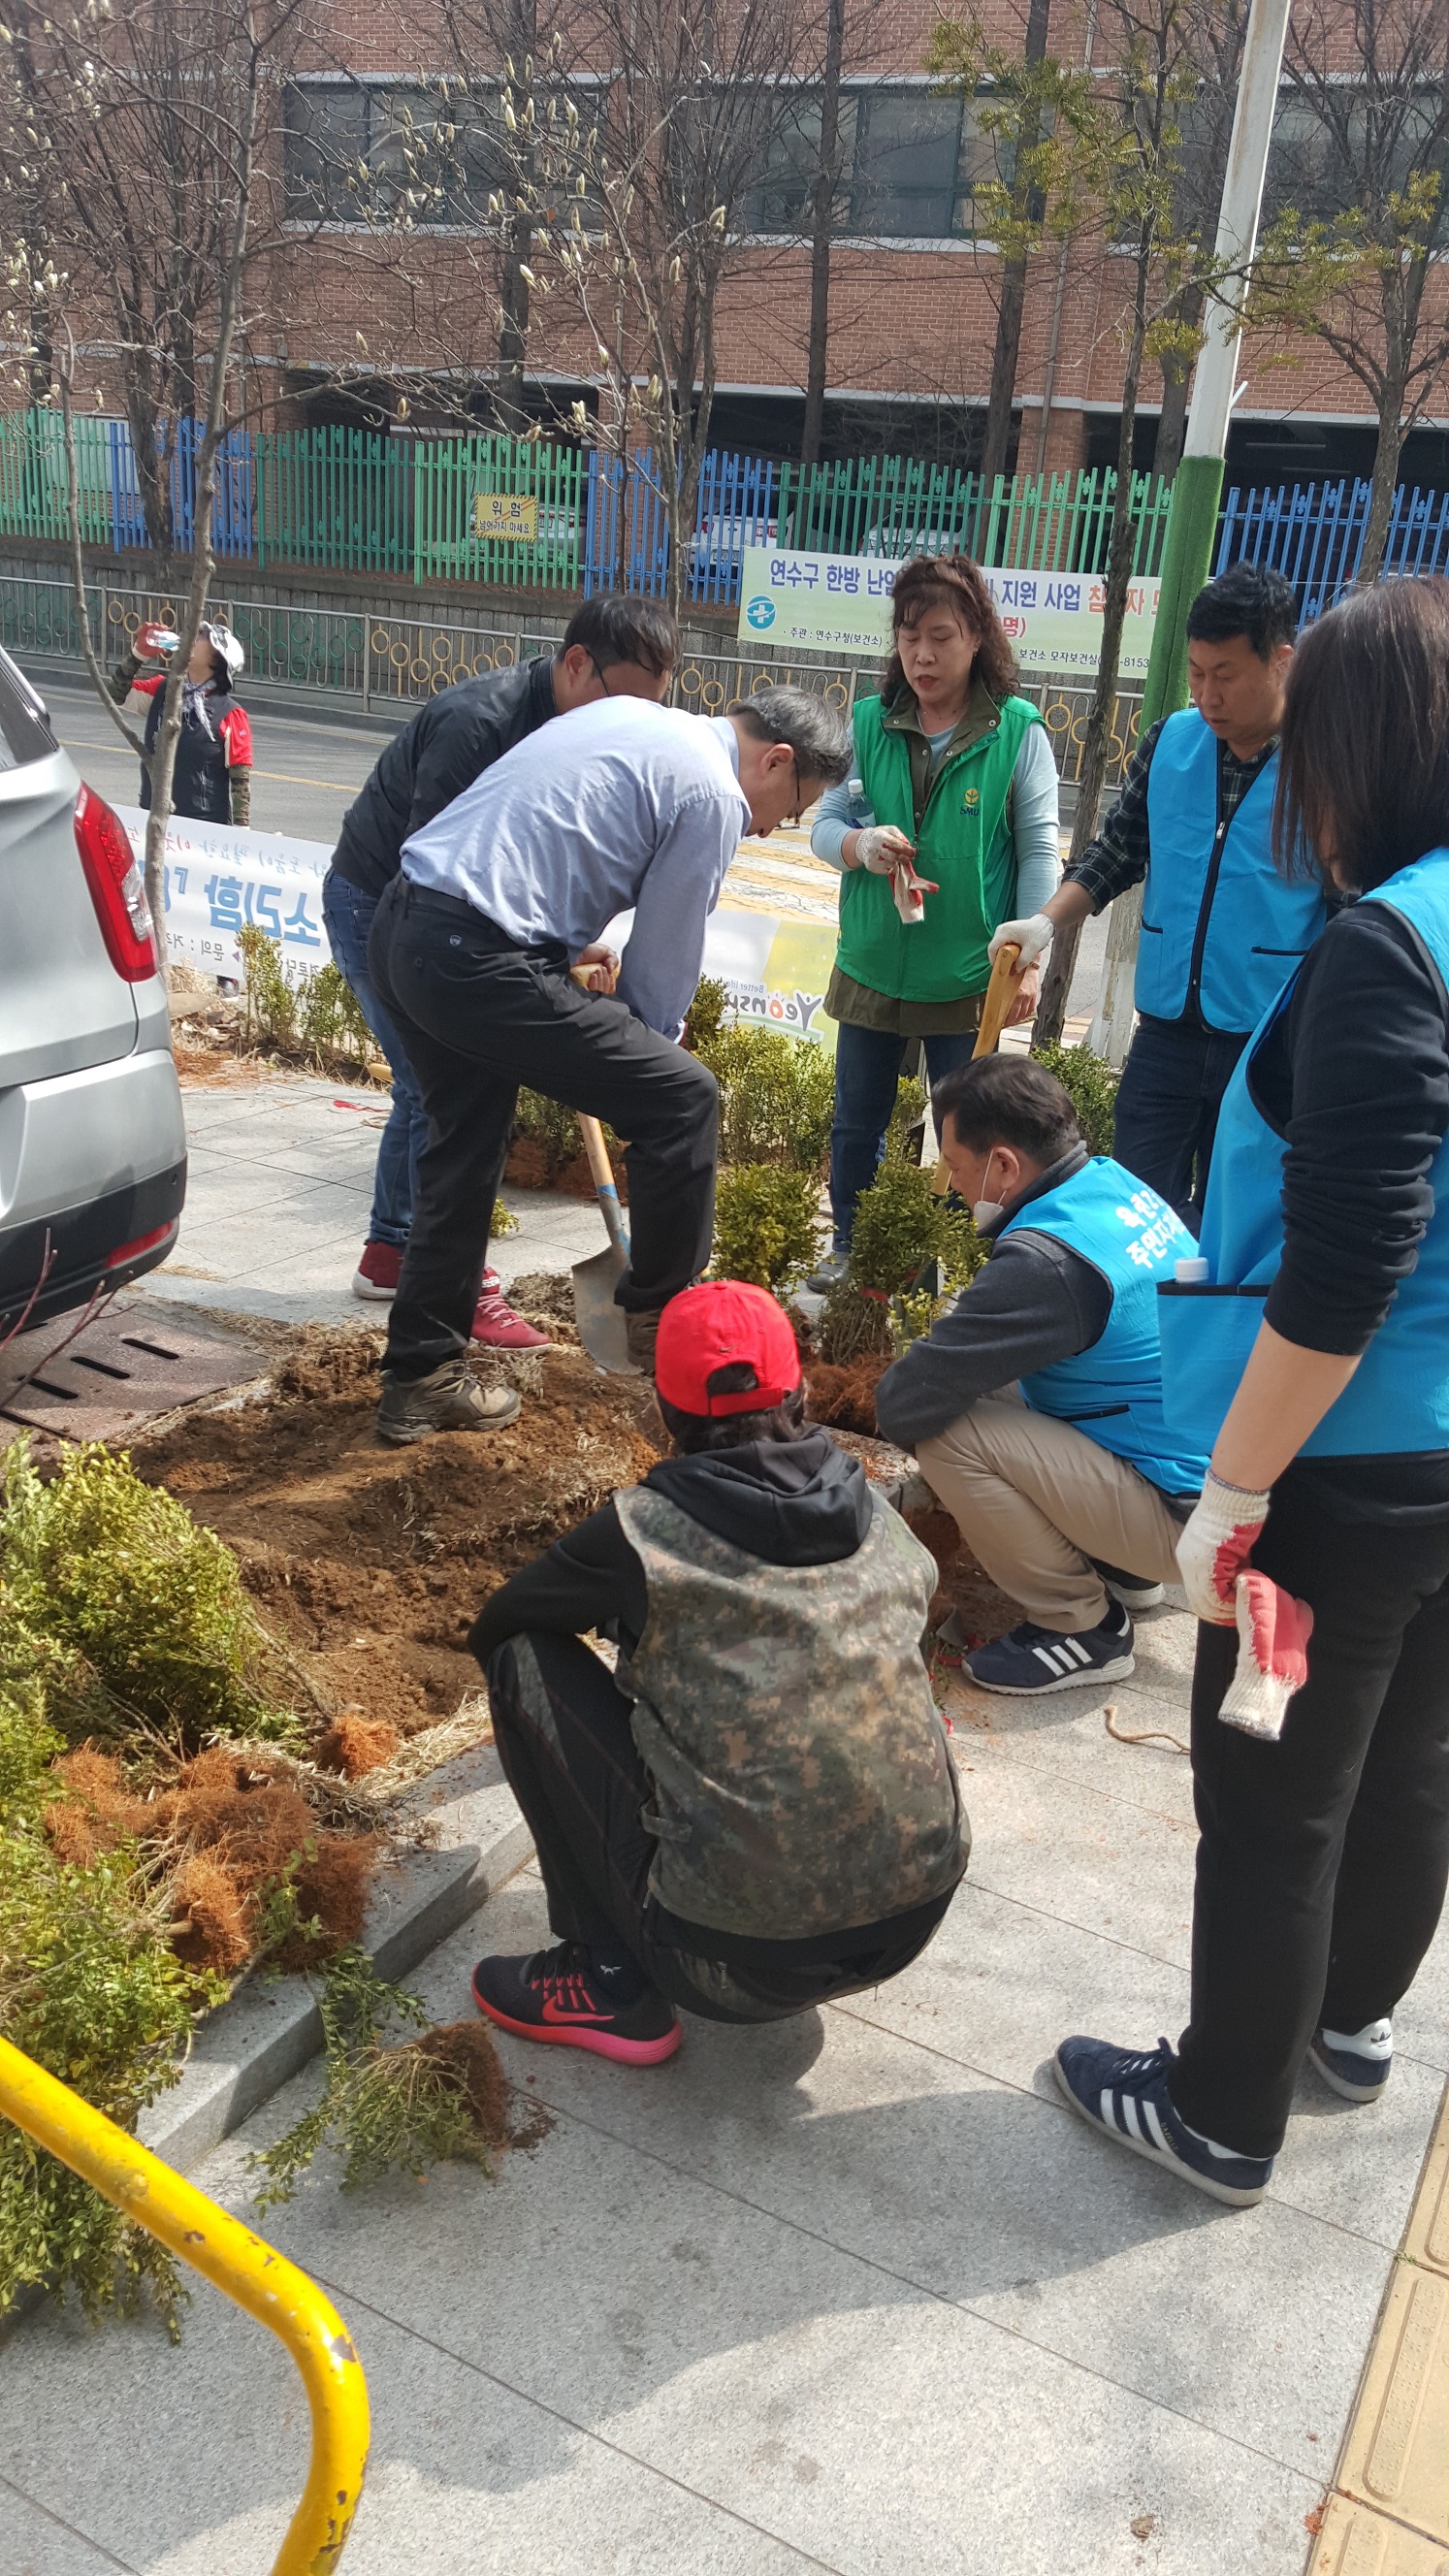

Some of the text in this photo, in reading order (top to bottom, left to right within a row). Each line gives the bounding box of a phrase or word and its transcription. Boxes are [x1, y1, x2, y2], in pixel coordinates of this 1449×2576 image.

[492, 500, 521, 517] 위 험
[479, 520, 507, 531] 넘어가지
[509, 522, 532, 533] 마세요.
[770, 559, 820, 590] 연수구
[826, 564, 860, 594] 한방
[1001, 580, 1038, 608] 지원
[1044, 583, 1081, 611] 사업
[1088, 585, 1145, 616] 참자
[789, 627, 807, 639] 주관
[816, 629, 883, 648] 연수구청(보건소)
[1018, 648, 1046, 660] 보건소
